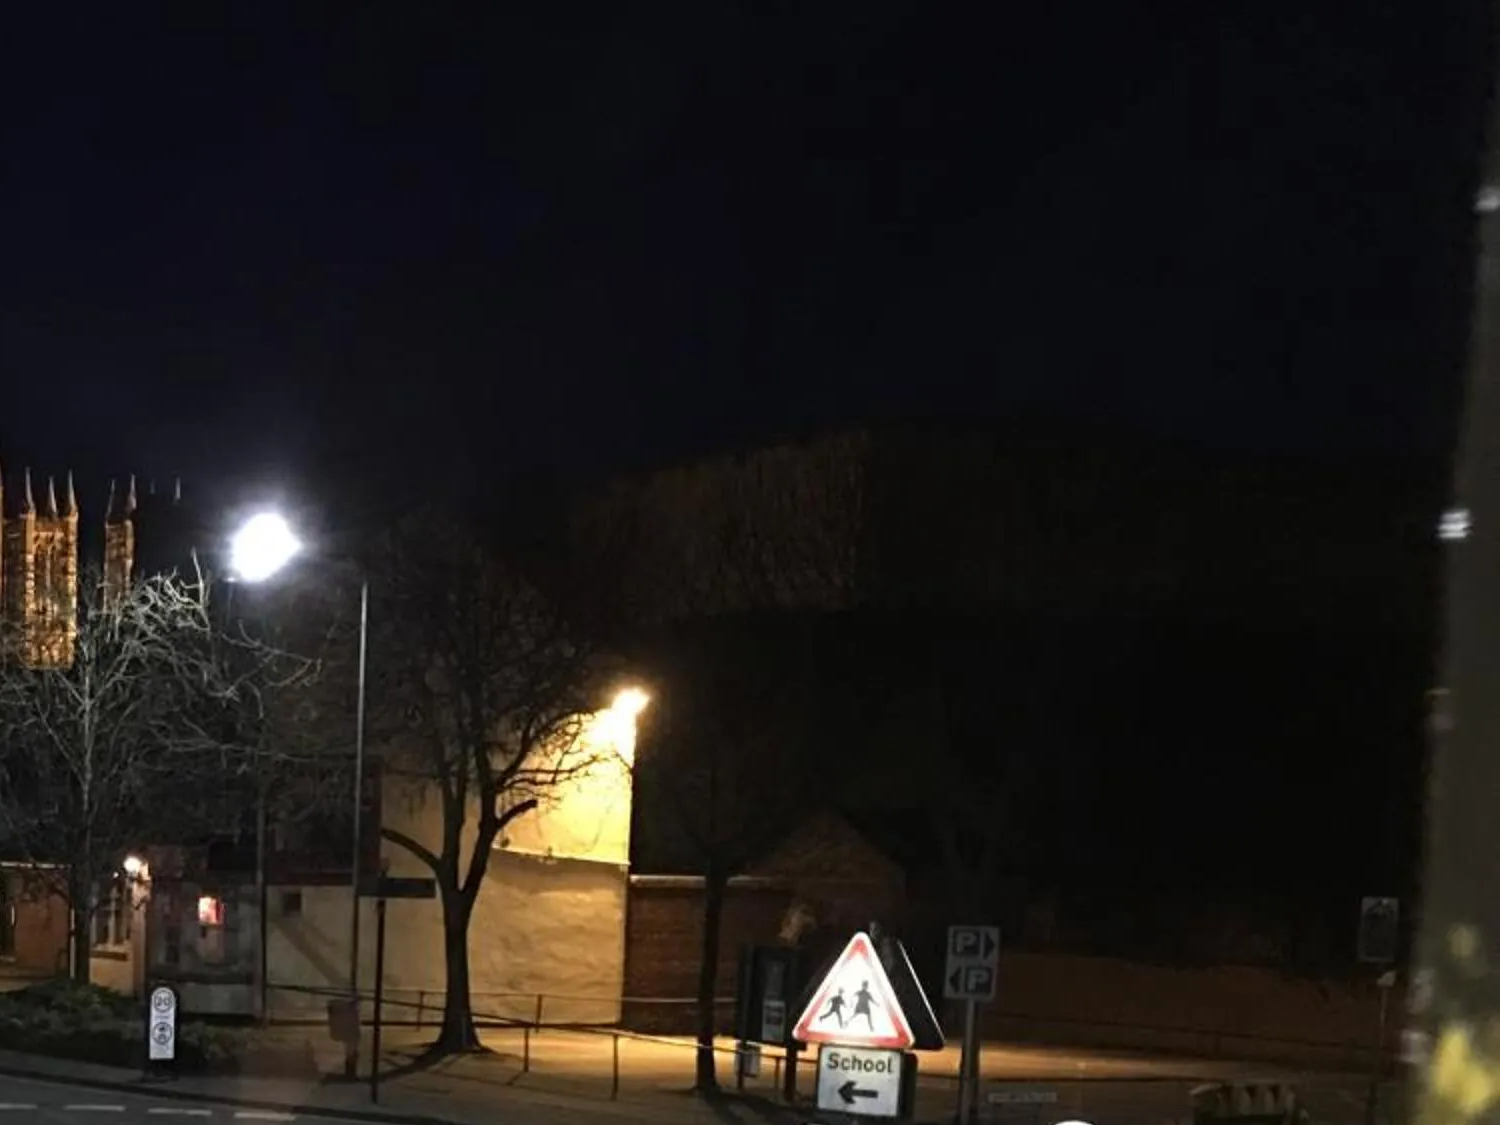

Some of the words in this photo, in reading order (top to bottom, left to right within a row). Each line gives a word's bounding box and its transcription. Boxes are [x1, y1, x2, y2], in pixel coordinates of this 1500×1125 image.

[956, 932, 977, 952] P
[968, 970, 989, 991] P
[827, 1052, 892, 1073] School
